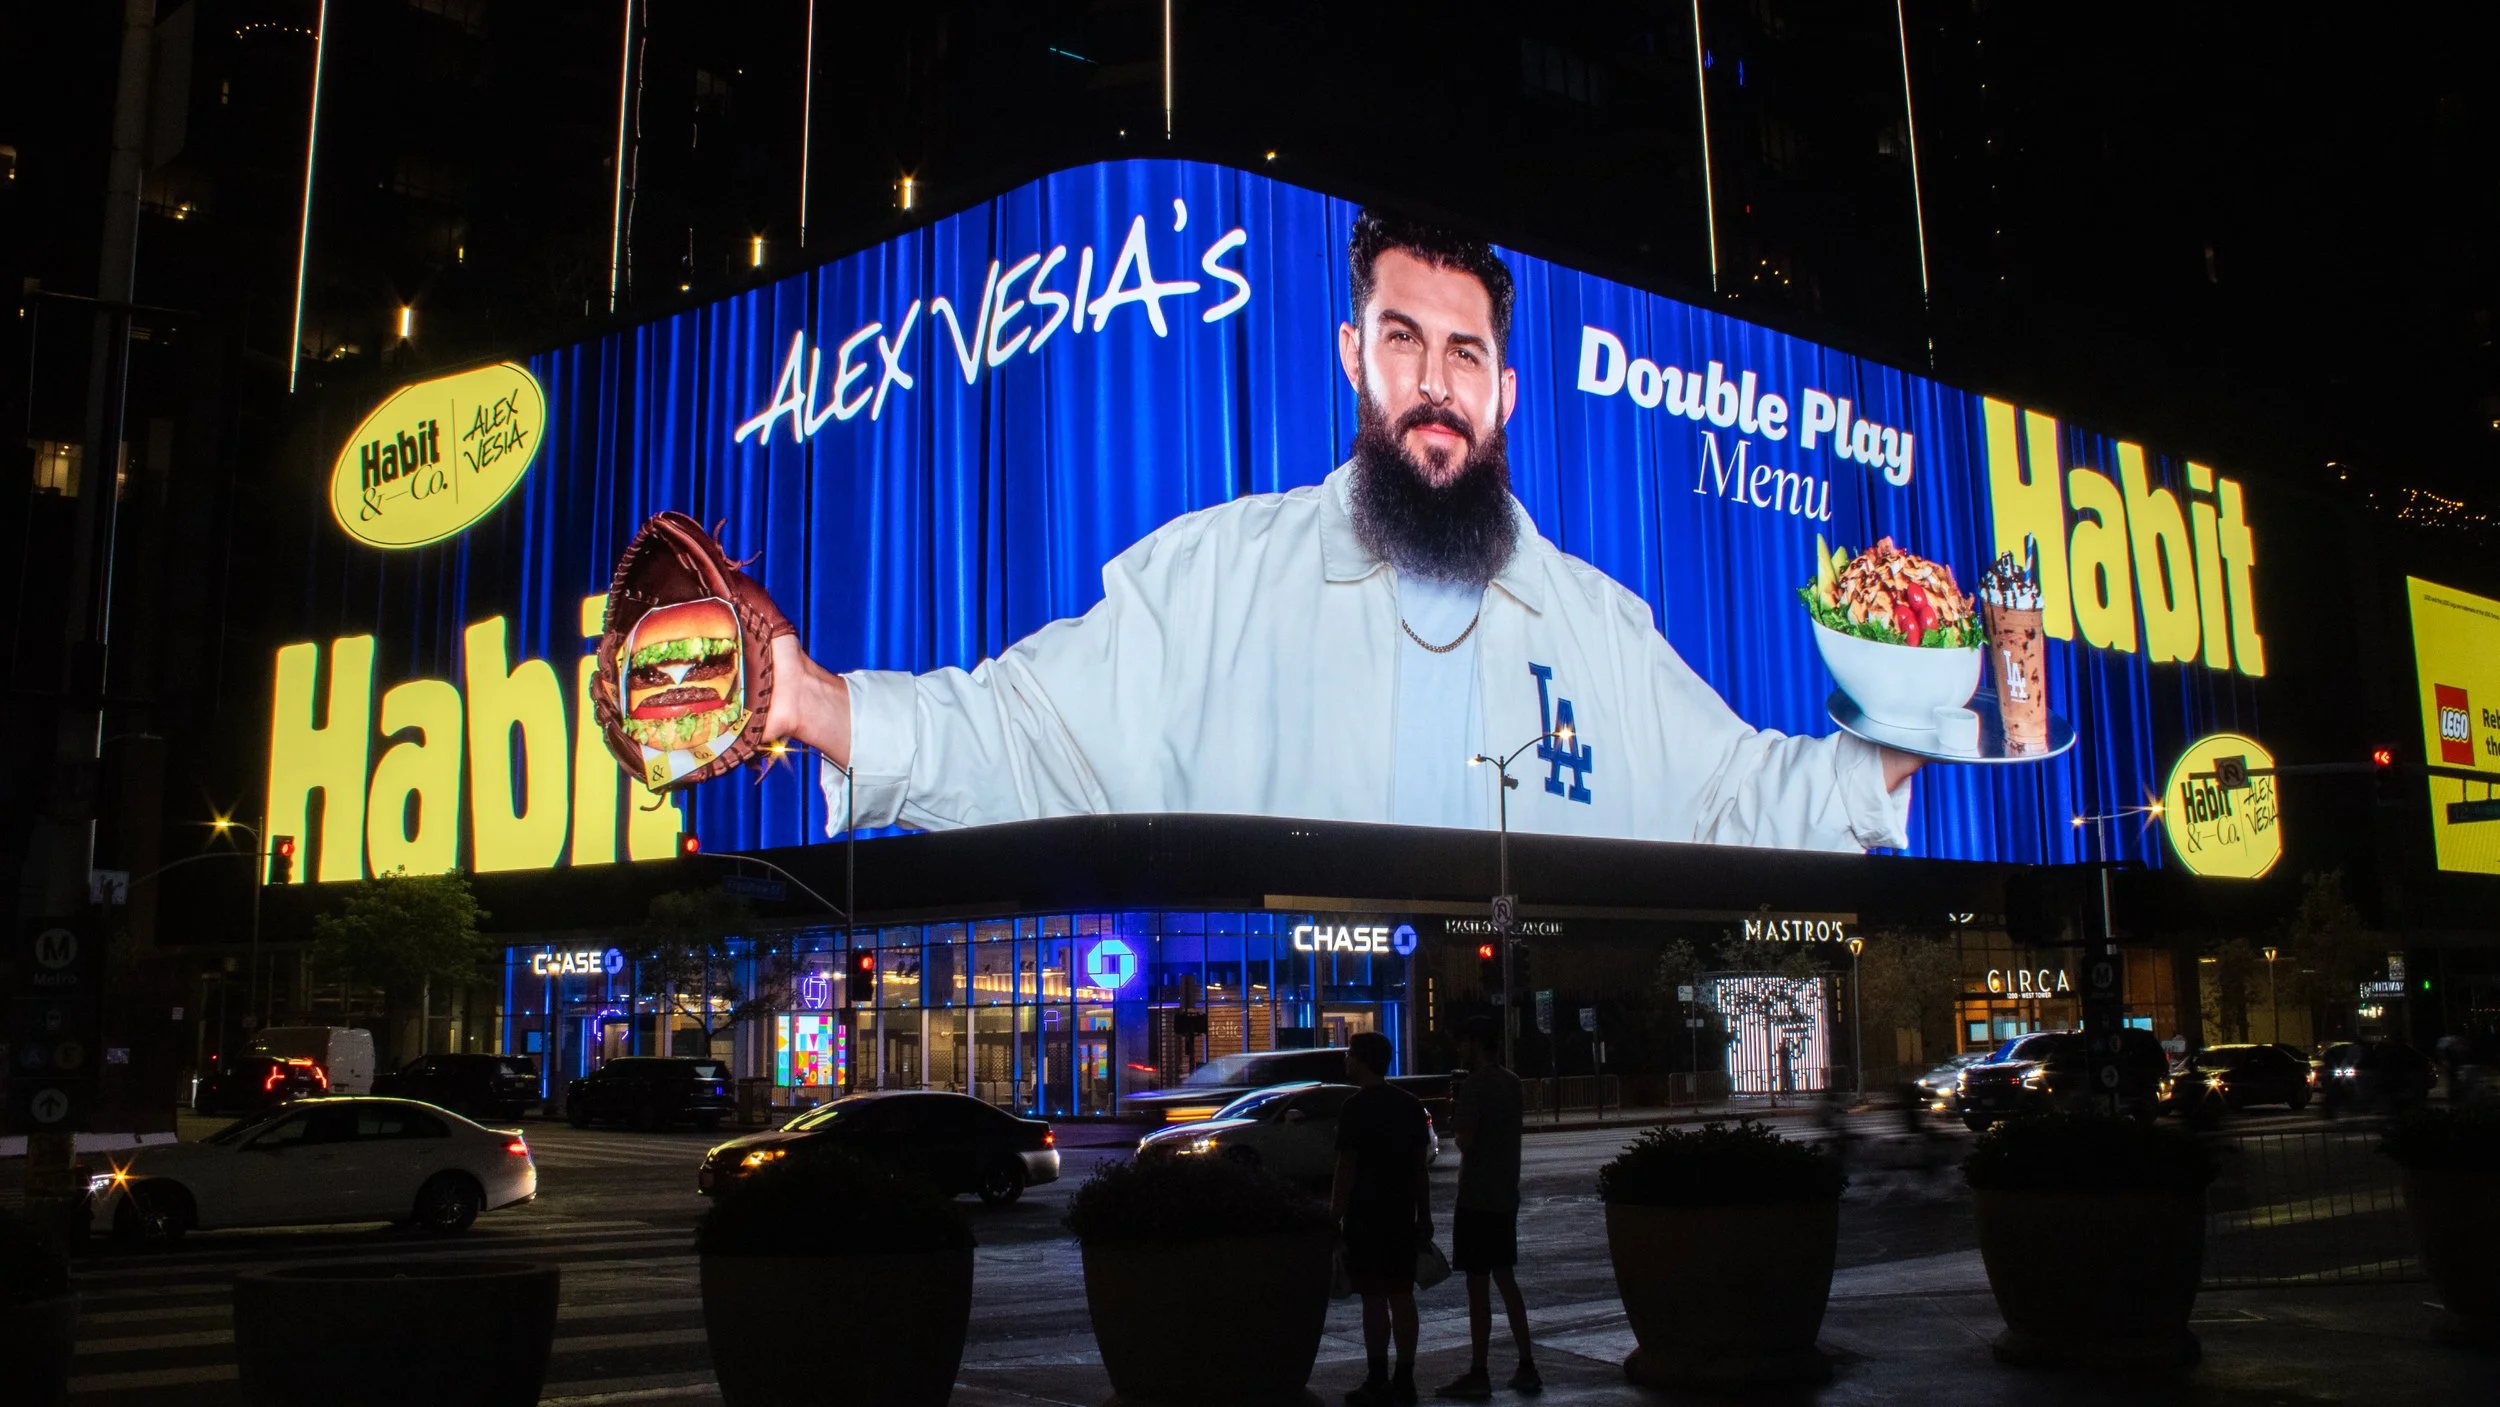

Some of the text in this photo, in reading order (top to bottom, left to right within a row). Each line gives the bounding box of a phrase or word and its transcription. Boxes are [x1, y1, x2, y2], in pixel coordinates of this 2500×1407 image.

[736, 299, 920, 445] ALEX
[463, 388, 519, 442] ALEX
[1577, 325, 1914, 487] Double Play
[360, 419, 440, 492] Habit
[464, 419, 529, 474] VESIA
[1693, 430, 1832, 522] Menu
[1983, 396, 2266, 677] Habit
[2002, 650, 2028, 699] LA
[264, 592, 684, 885] Habi
[1528, 661, 1593, 805] LA
[2441, 709, 2469, 741] LEGO
[1294, 925, 1390, 953] CHASE
[1744, 919, 1844, 942] MASTRO'S
[1987, 968, 2071, 993] CIRCA
